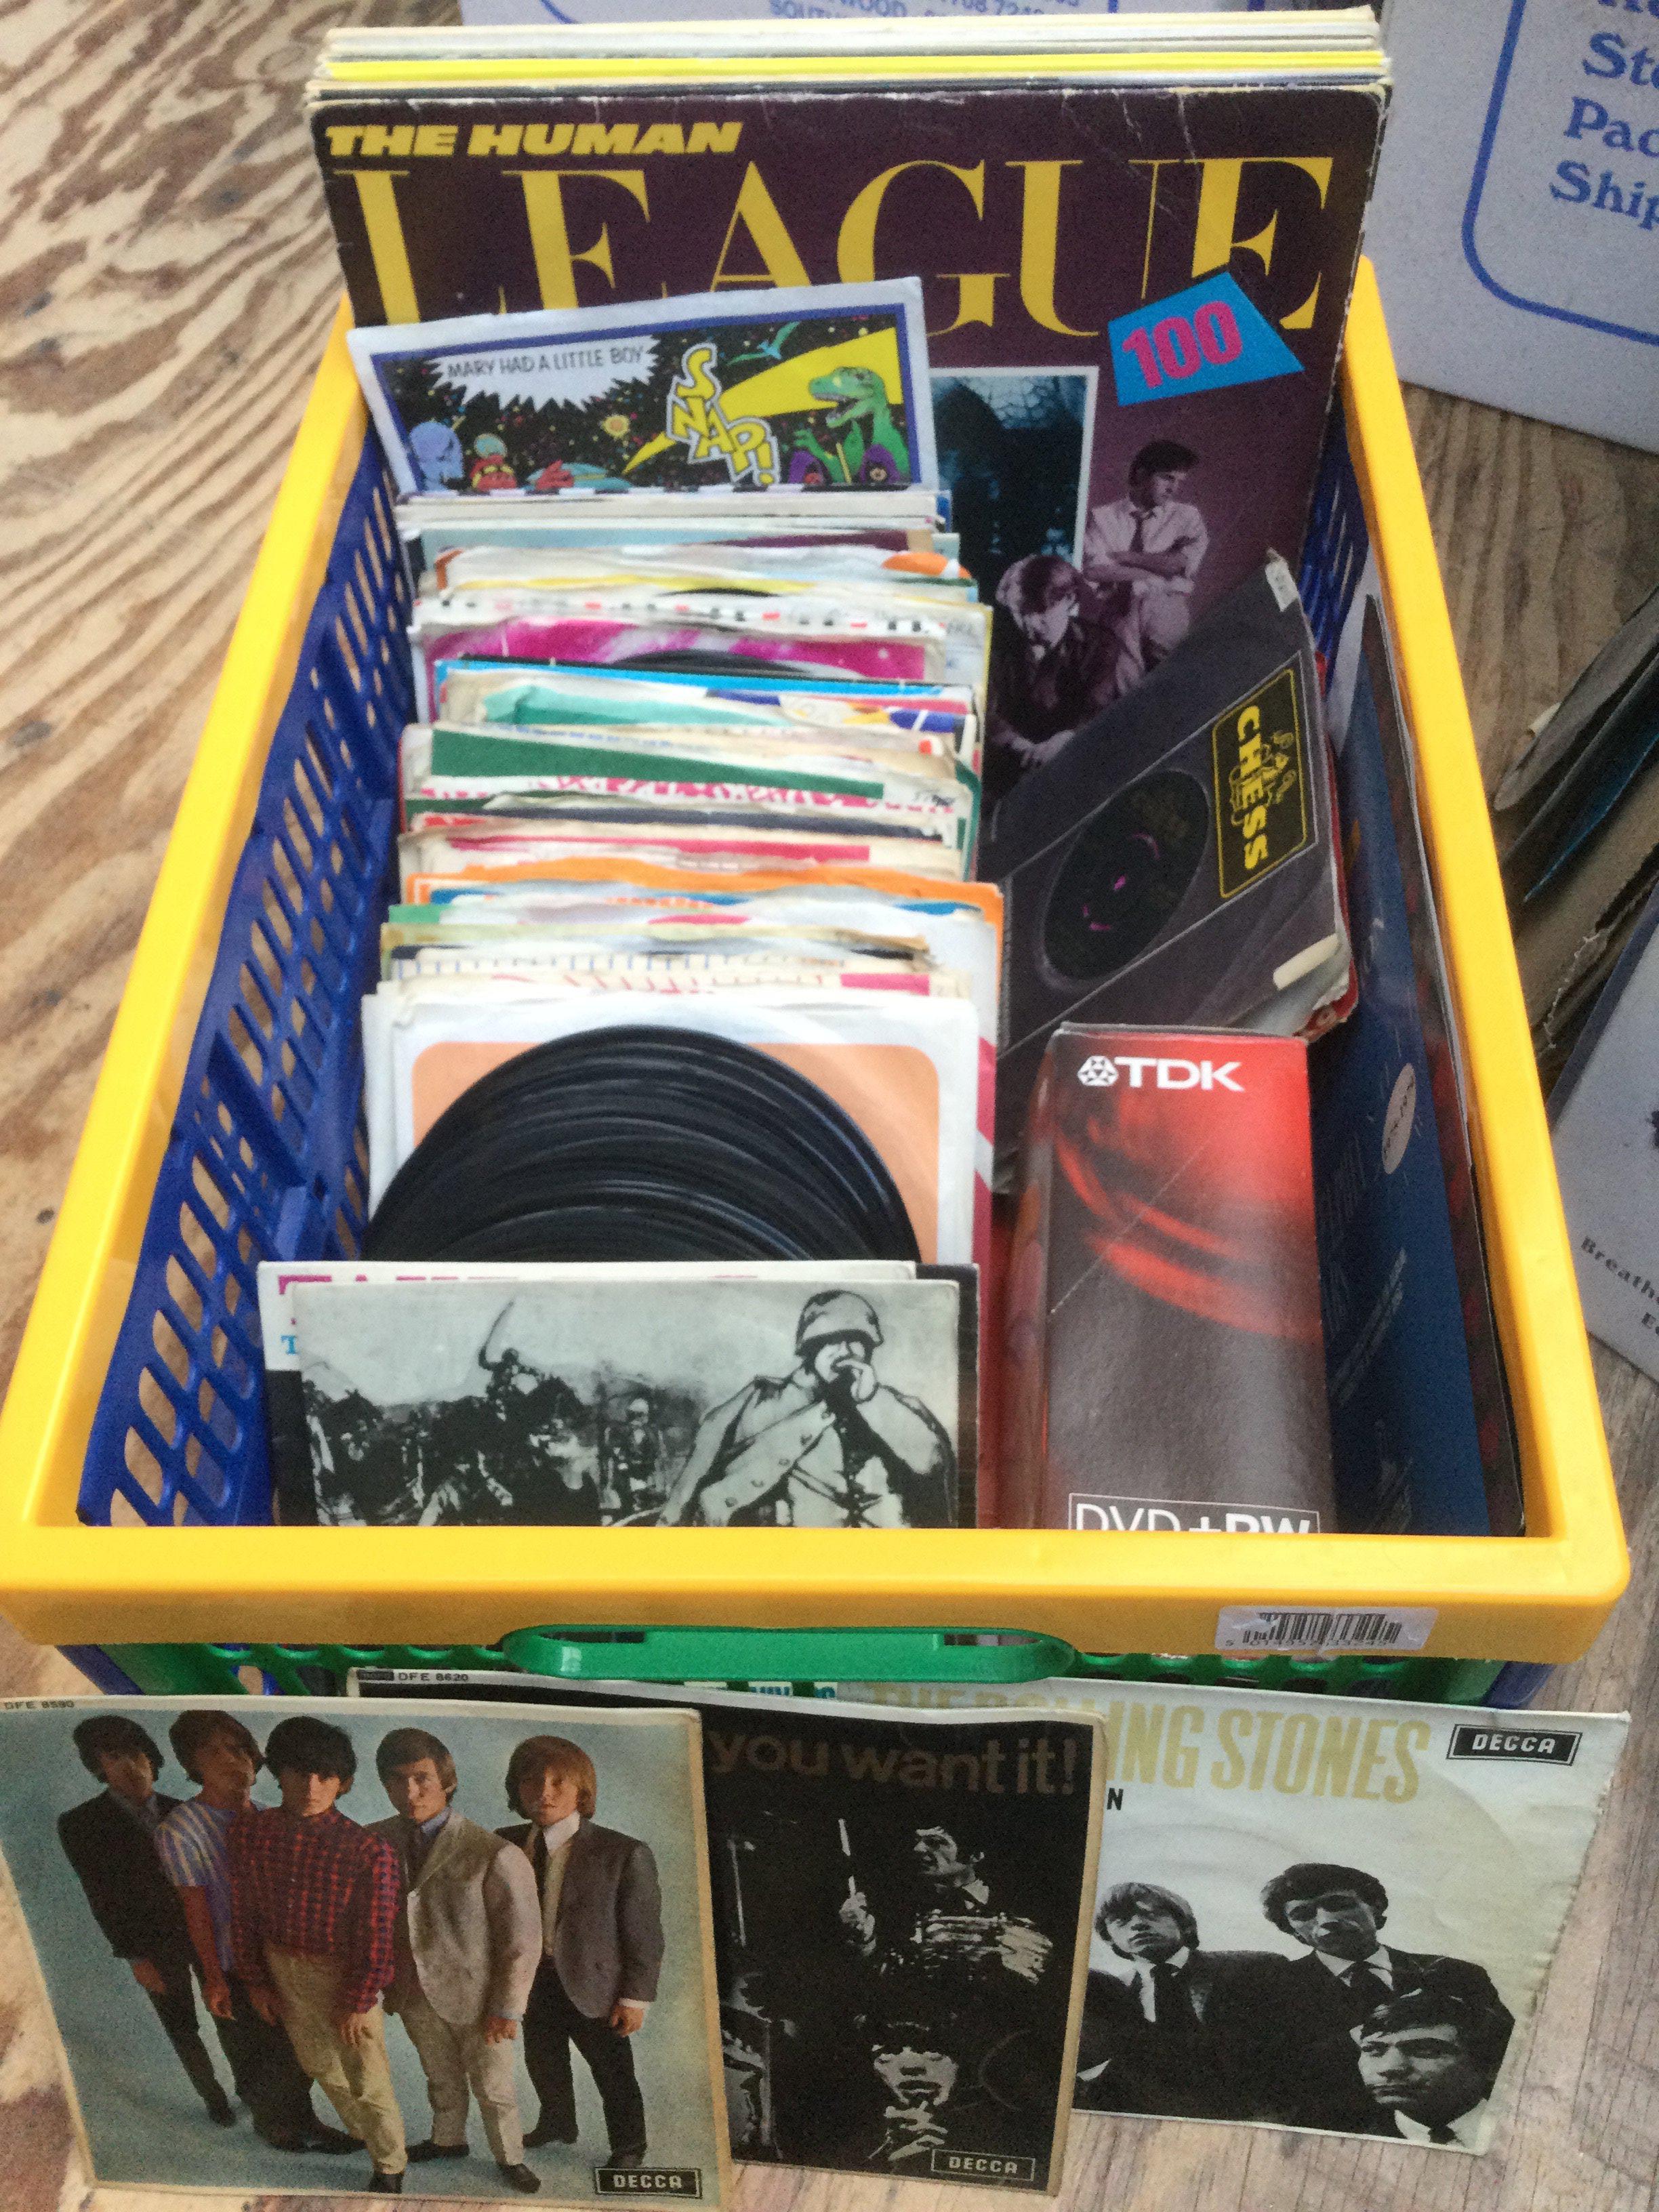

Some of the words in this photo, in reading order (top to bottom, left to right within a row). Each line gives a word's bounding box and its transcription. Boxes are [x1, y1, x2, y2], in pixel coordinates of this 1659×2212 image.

[325, 125, 459, 157] THE
[468, 121, 743, 157] HUMAN
[334, 157, 1334, 337] LEAGUE
[447, 359, 495, 378] MARY
[499, 354, 535, 374] HAD
[539, 353, 550, 373] A
[553, 348, 605, 371] LITTLE
[609, 345, 644, 365] BOY
[1122, 300, 1244, 389] 100
[670, 346, 777, 485] SNAP!
[1237, 705, 1269, 870] CHESS
[1114, 1056, 1245, 1092] TDK
[398, 1672, 430, 1681] DFE
[1210, 1708, 1432, 1804] STONES
[1472, 1734, 1556, 1754] DECCA
[708, 1730, 831, 1774] you
[840, 1737, 1005, 1794] want
[1019, 1736, 1079, 1795] it!
[613, 2174, 682, 2188] DECCA
[949, 2156, 1018, 2174] DECCA
